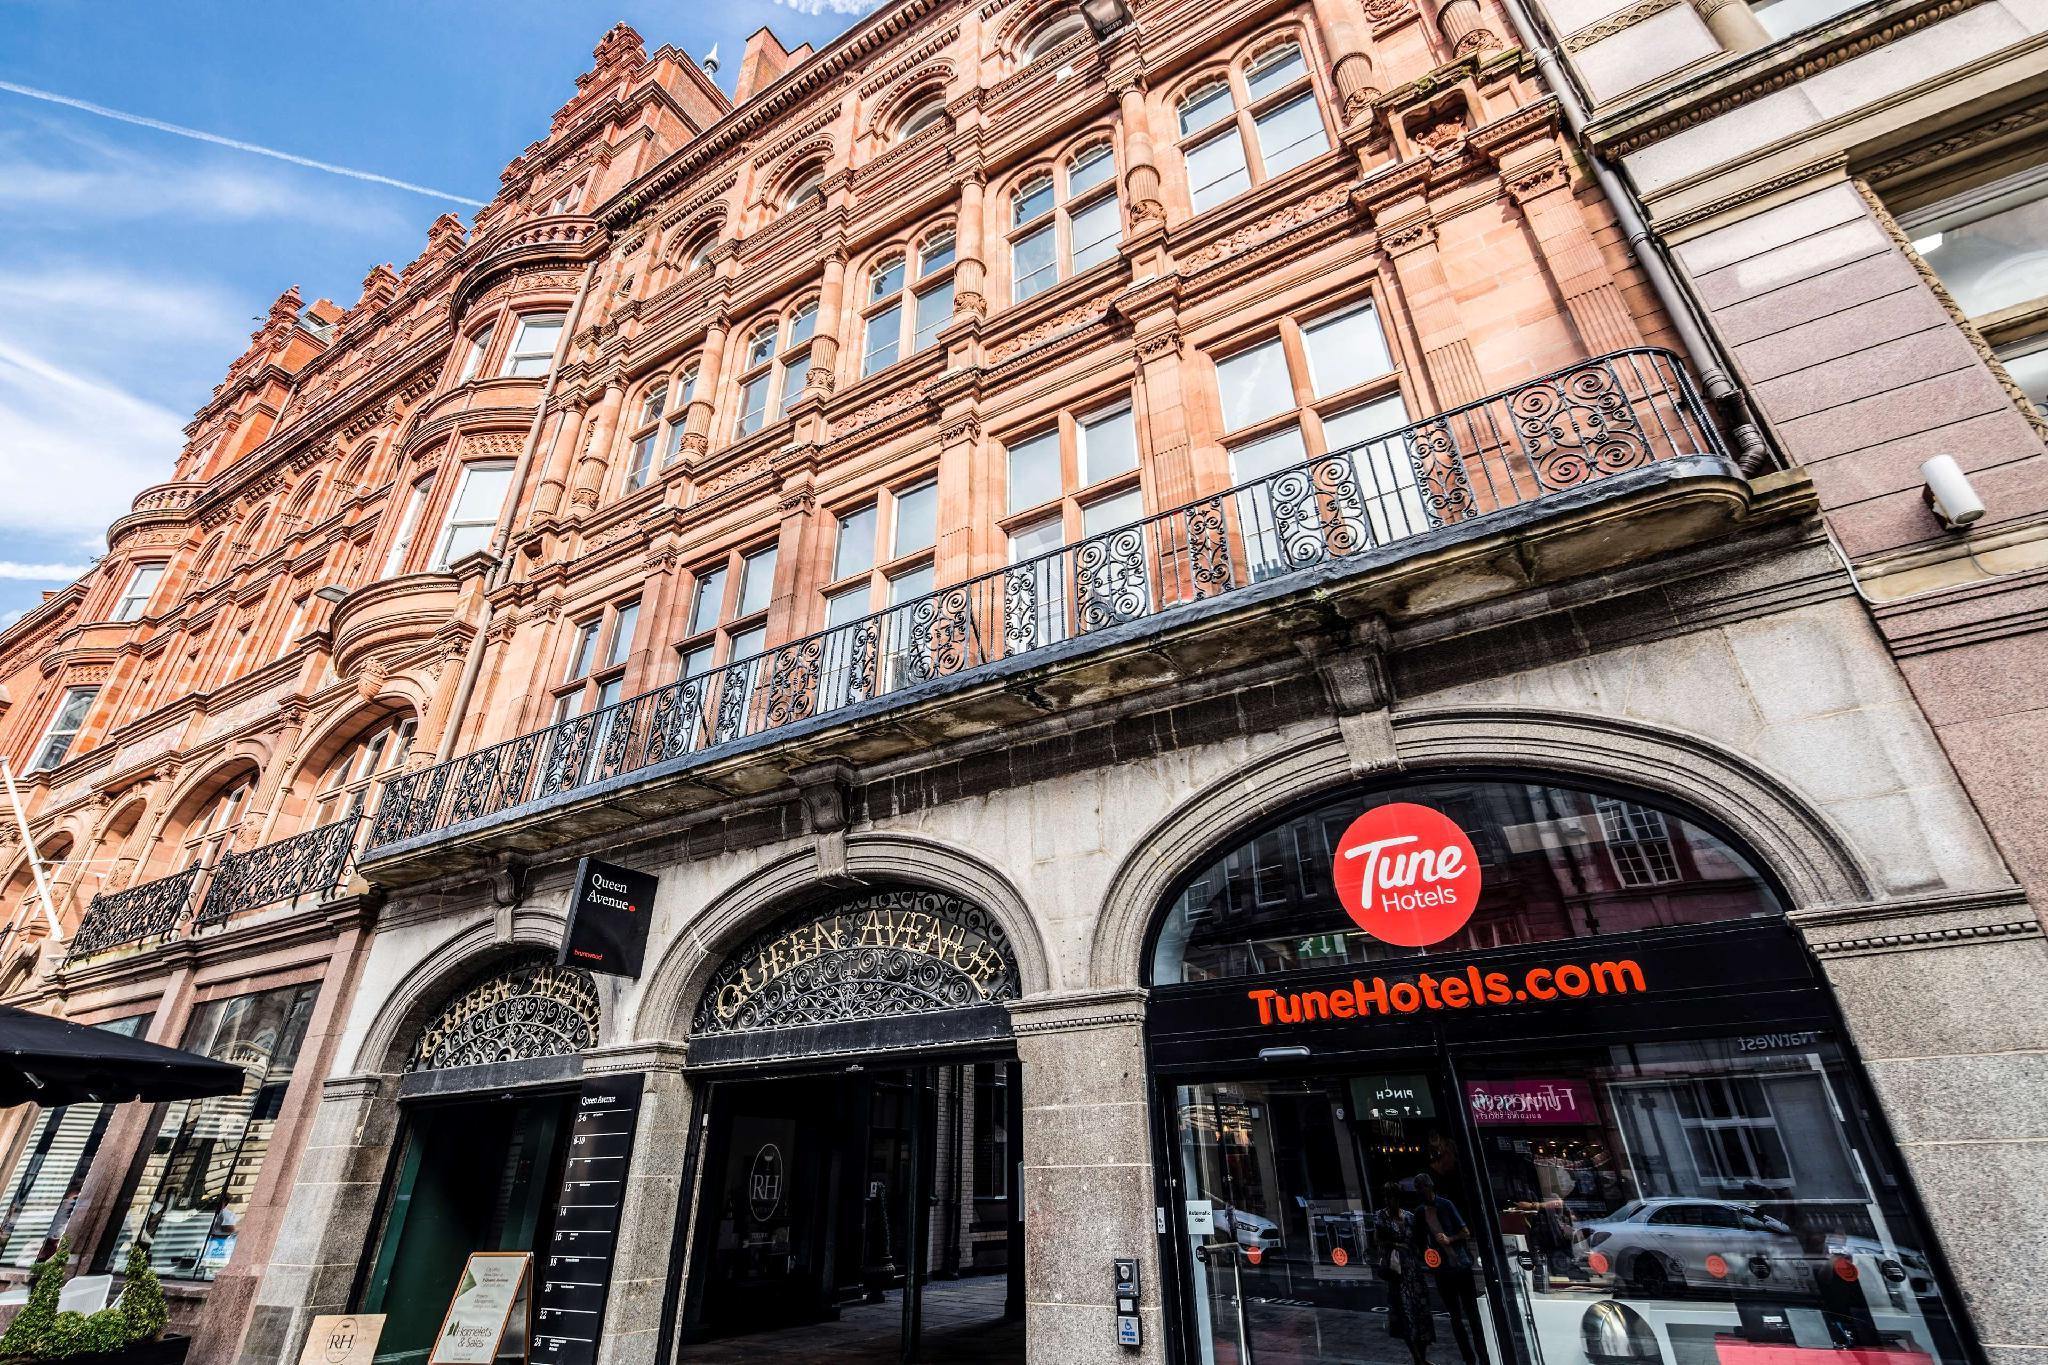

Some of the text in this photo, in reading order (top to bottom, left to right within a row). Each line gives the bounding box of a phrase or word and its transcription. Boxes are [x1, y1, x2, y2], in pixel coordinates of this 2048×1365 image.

[592, 873, 628, 894] Queen
[1344, 835, 1467, 910] Tune
[1381, 885, 1458, 913] Hotels
[714, 909, 1006, 1019] QUEEN AVENUE
[1247, 958, 1648, 1026] TuneHotels.com
[420, 972, 511, 1059] QUEEN
[581, 1096, 597, 1107] Queen
[564, 1183, 572, 1192] 12
[751, 1174, 780, 1200] RH
[559, 1207, 567, 1216] 14
[554, 1232, 562, 1241] 16
[329, 1334, 355, 1349] RH
